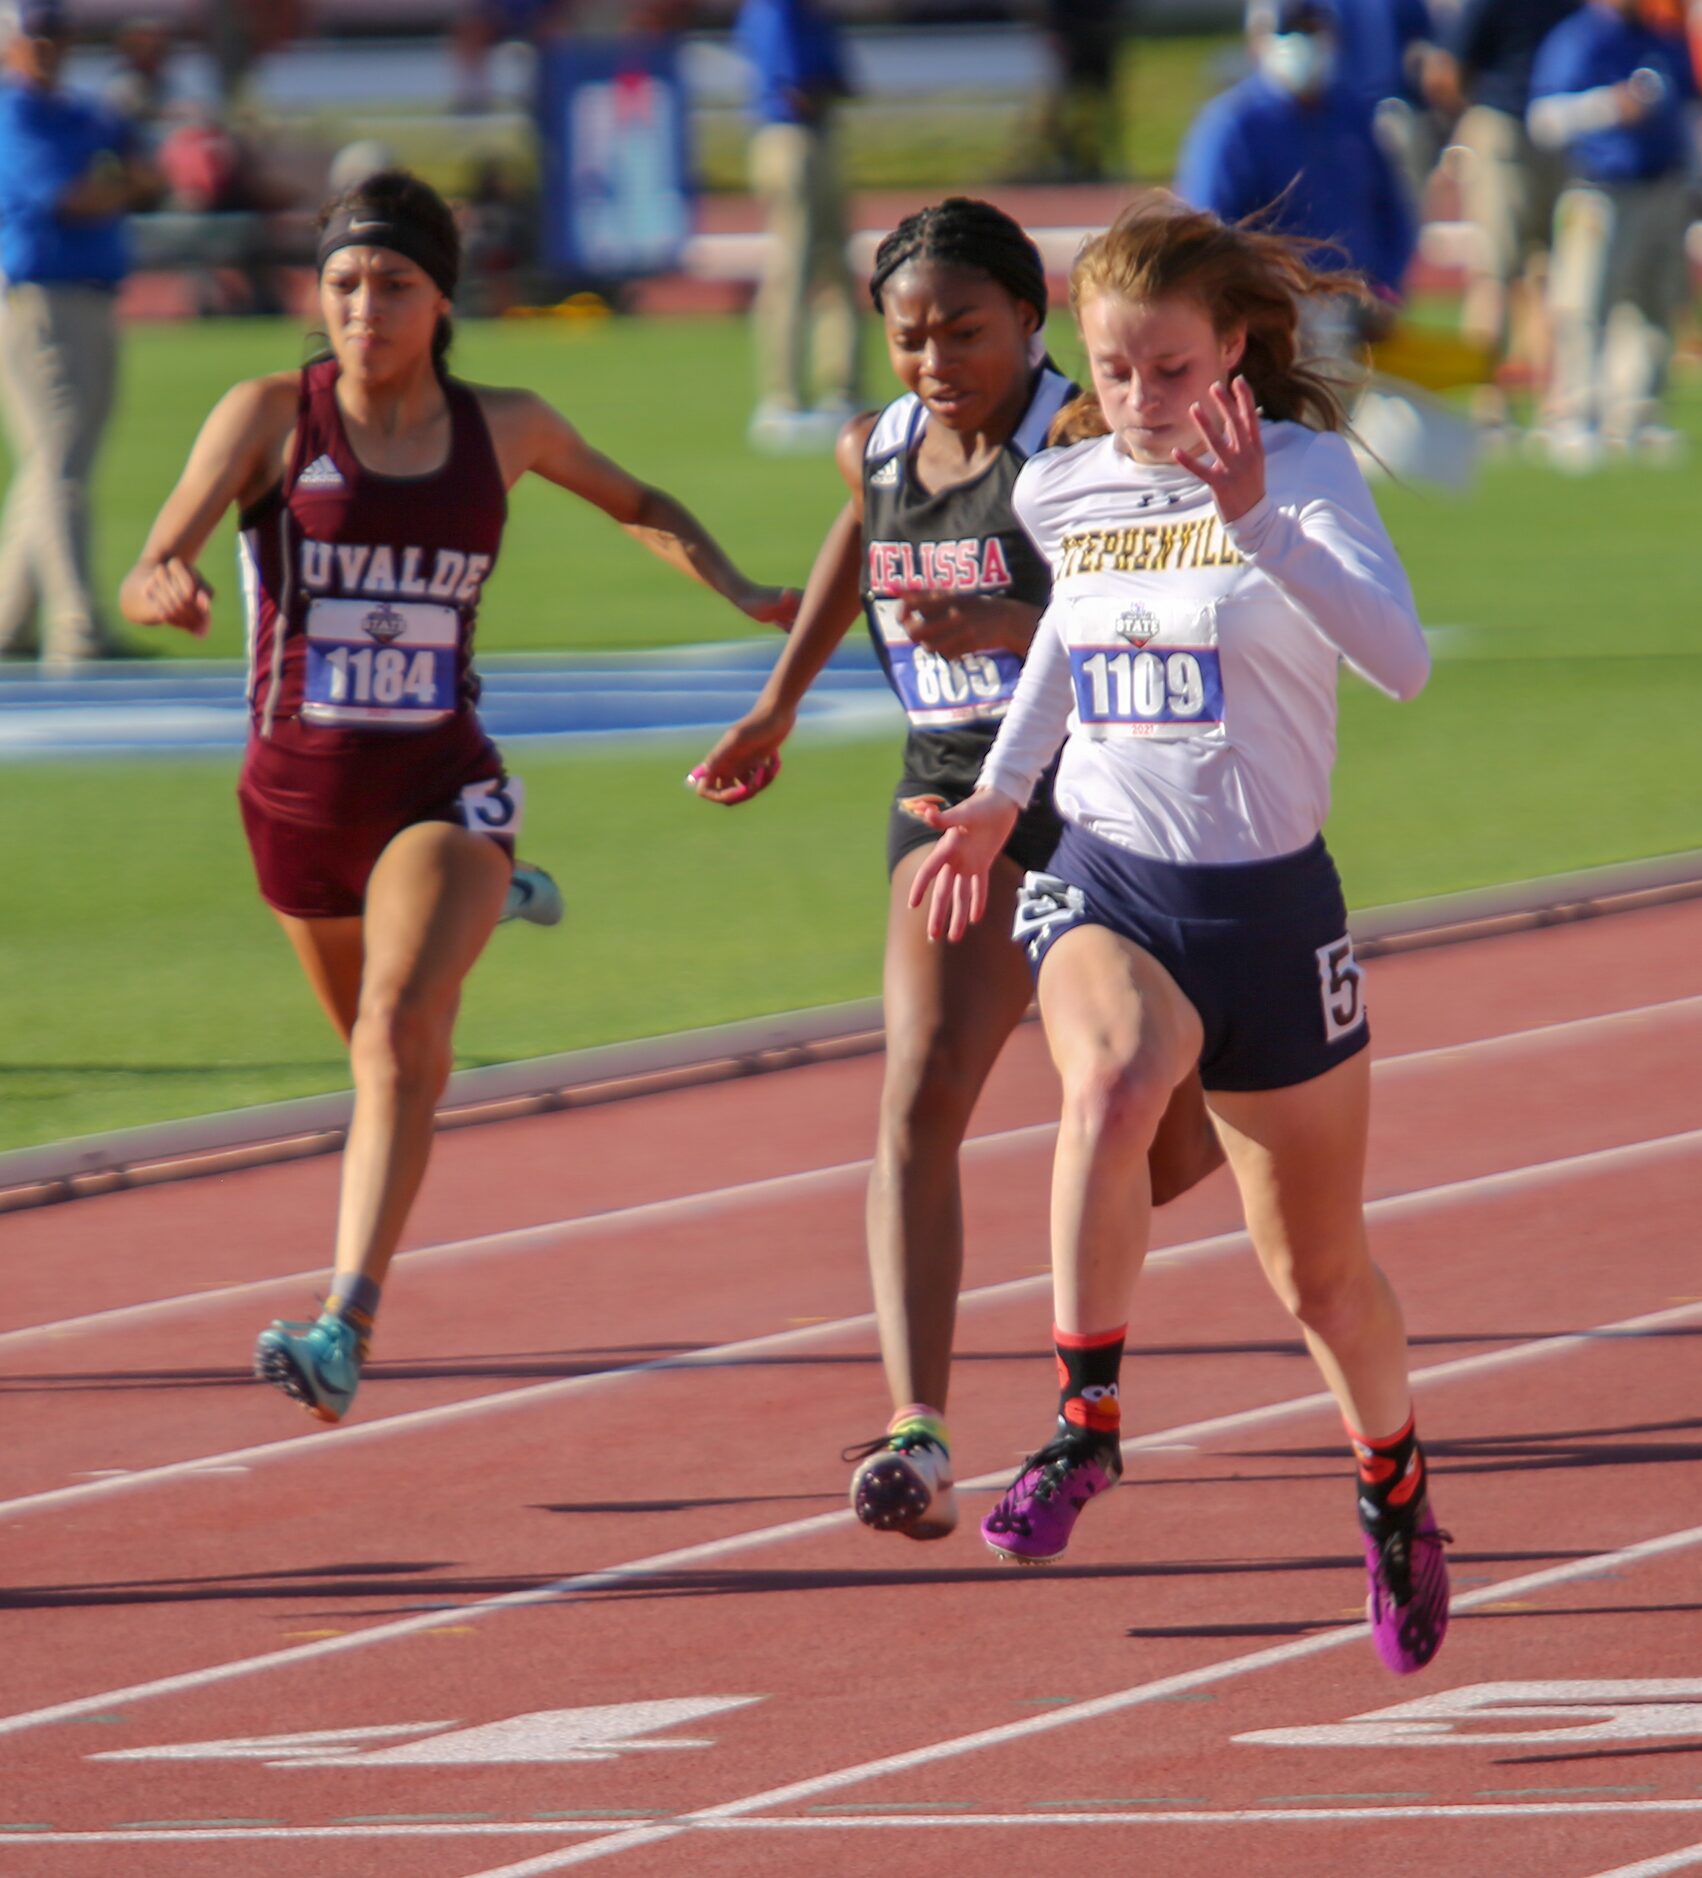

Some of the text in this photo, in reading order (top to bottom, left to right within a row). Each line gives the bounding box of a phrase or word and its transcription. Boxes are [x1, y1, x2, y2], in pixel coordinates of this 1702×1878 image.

[301, 540, 491, 602] UVALDE
[1116, 618, 1160, 636] STATE
[326, 646, 437, 704] 1184
[1083, 652, 1205, 717] 1109
[1131, 723, 1154, 736] 2021
[474, 776, 515, 828] 3
[1329, 943, 1360, 1027] 5
